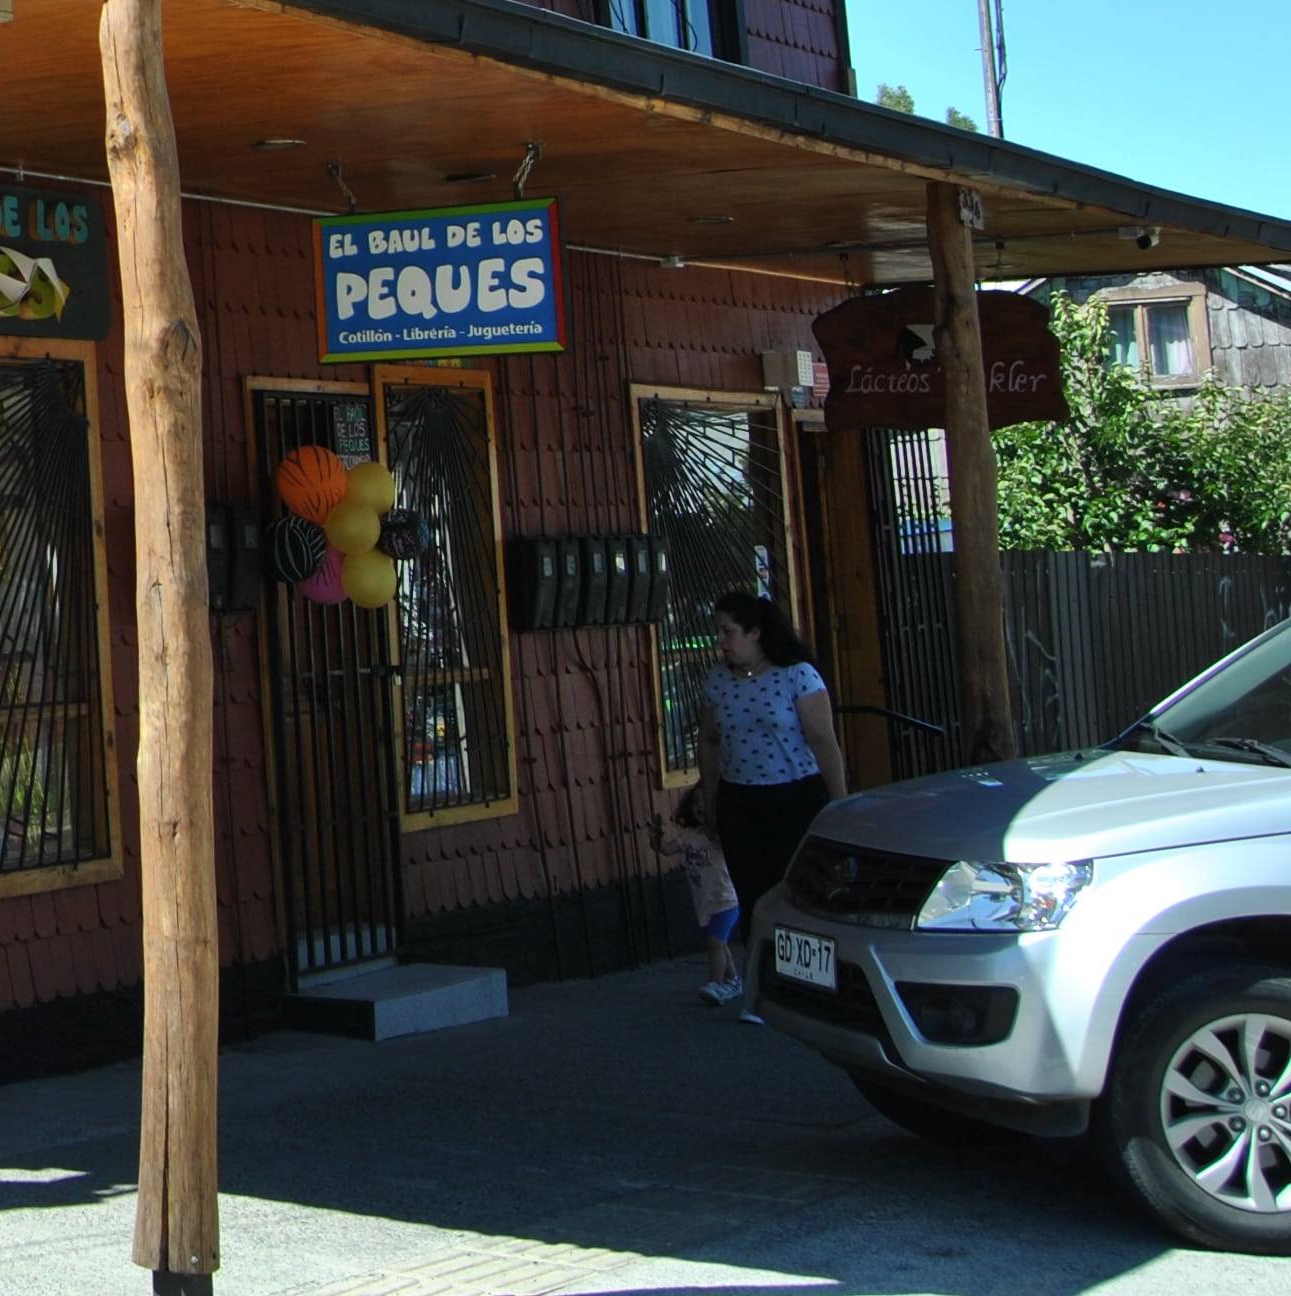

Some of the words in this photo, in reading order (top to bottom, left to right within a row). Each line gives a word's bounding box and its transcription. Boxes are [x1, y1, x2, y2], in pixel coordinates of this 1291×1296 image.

[29, 199, 88, 244] LOS
[329, 233, 358, 258] EL
[368, 227, 436, 254] BAUL
[446, 222, 481, 248] DE
[492, 219, 543, 245] LOS
[336, 257, 545, 320] PEQUES
[339, 327, 392, 344] Cotillón
[467, 320, 542, 340] Juguetería
[845, 364, 931, 393] Lácteos
[348, 423, 365, 437] LOS
